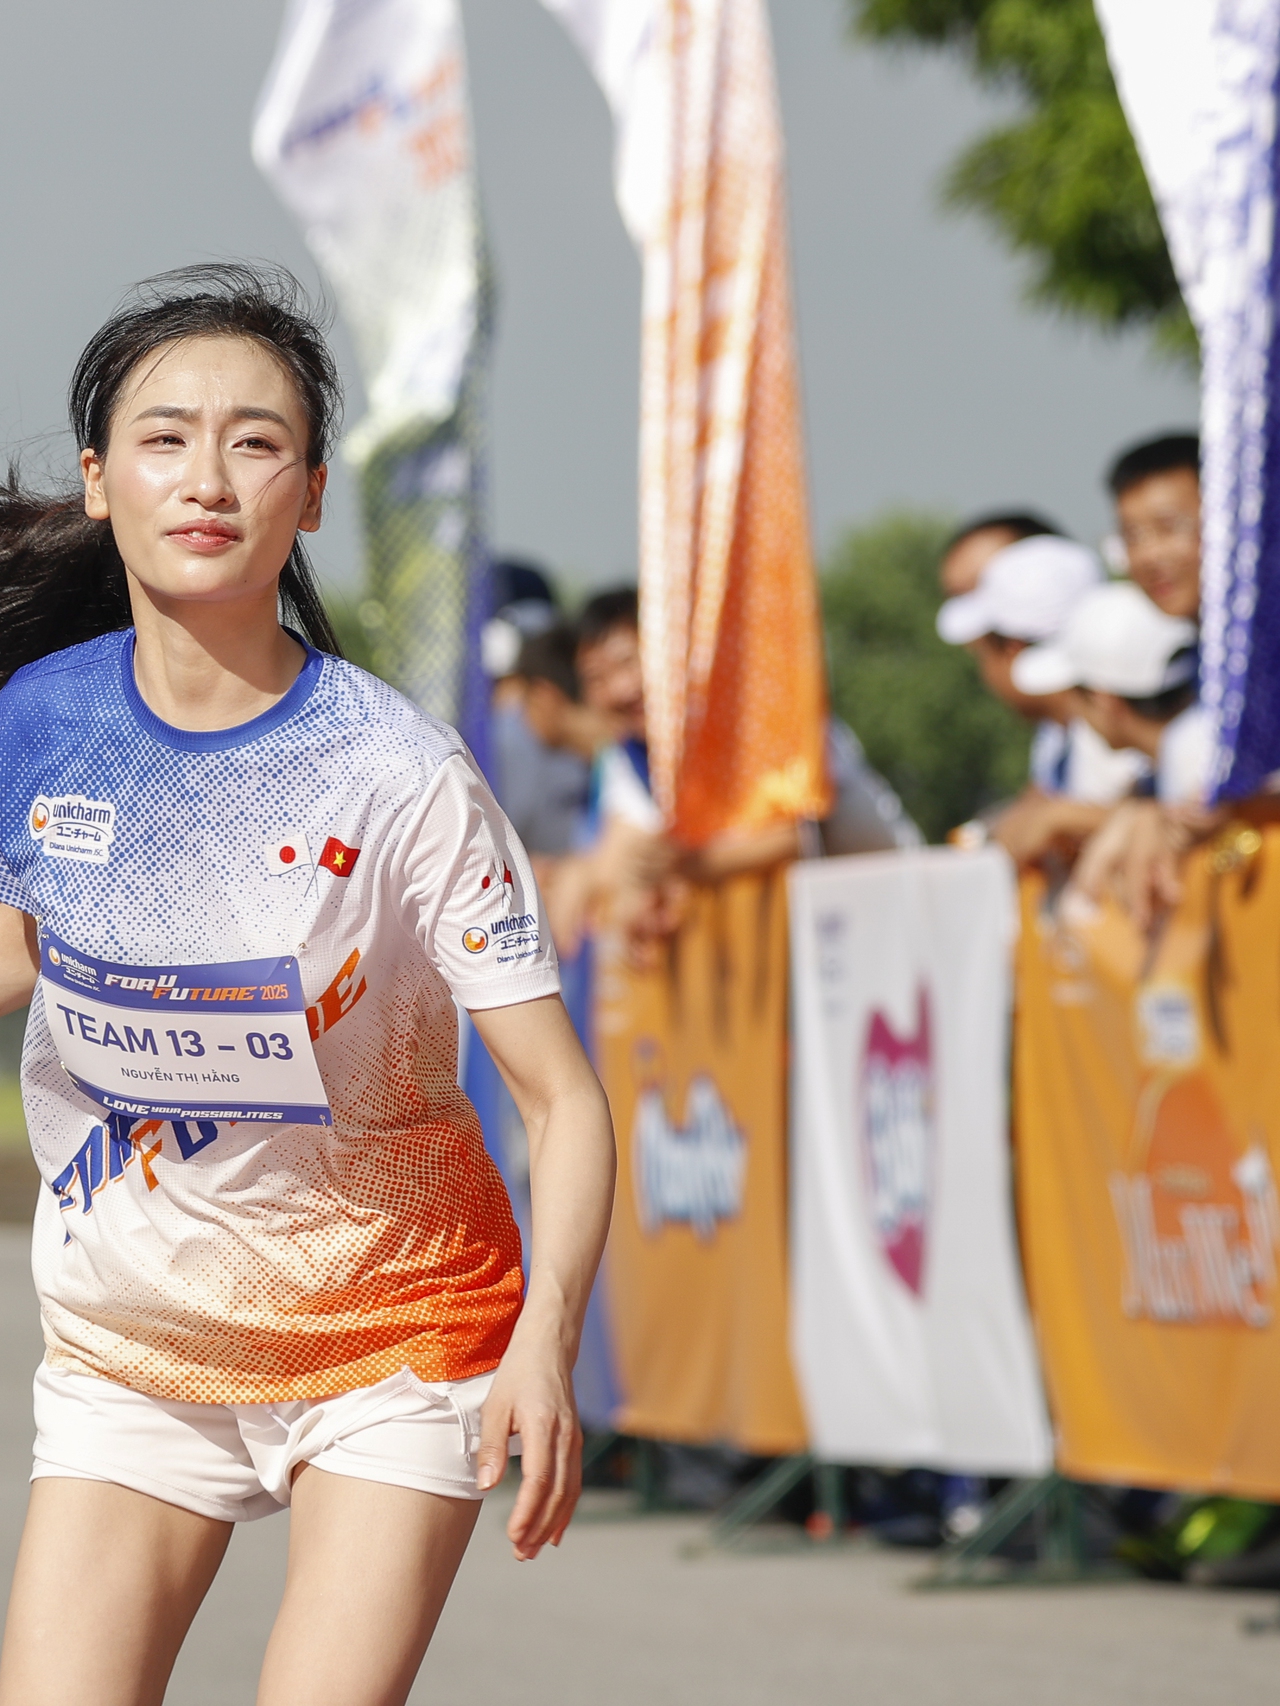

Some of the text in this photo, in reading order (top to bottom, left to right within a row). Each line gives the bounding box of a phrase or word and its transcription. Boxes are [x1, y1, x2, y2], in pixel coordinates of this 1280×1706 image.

[53, 801, 111, 824] unicharm
[49, 841, 65, 850] Diana
[66, 844, 92, 855] Unicharm
[60, 952, 98, 976] unicharm
[497, 955, 515, 964] Diana
[152, 983, 289, 1002] FUTURE 2025
[56, 1002, 160, 1056] TEAM
[165, 1029, 206, 1057] 13
[245, 1032, 294, 1061] 03
[121, 1067, 240, 1085] NGUYỄN THỊ HẰNG
[103, 1096, 283, 1120] LOVE YOUR POSSIBILITIES
